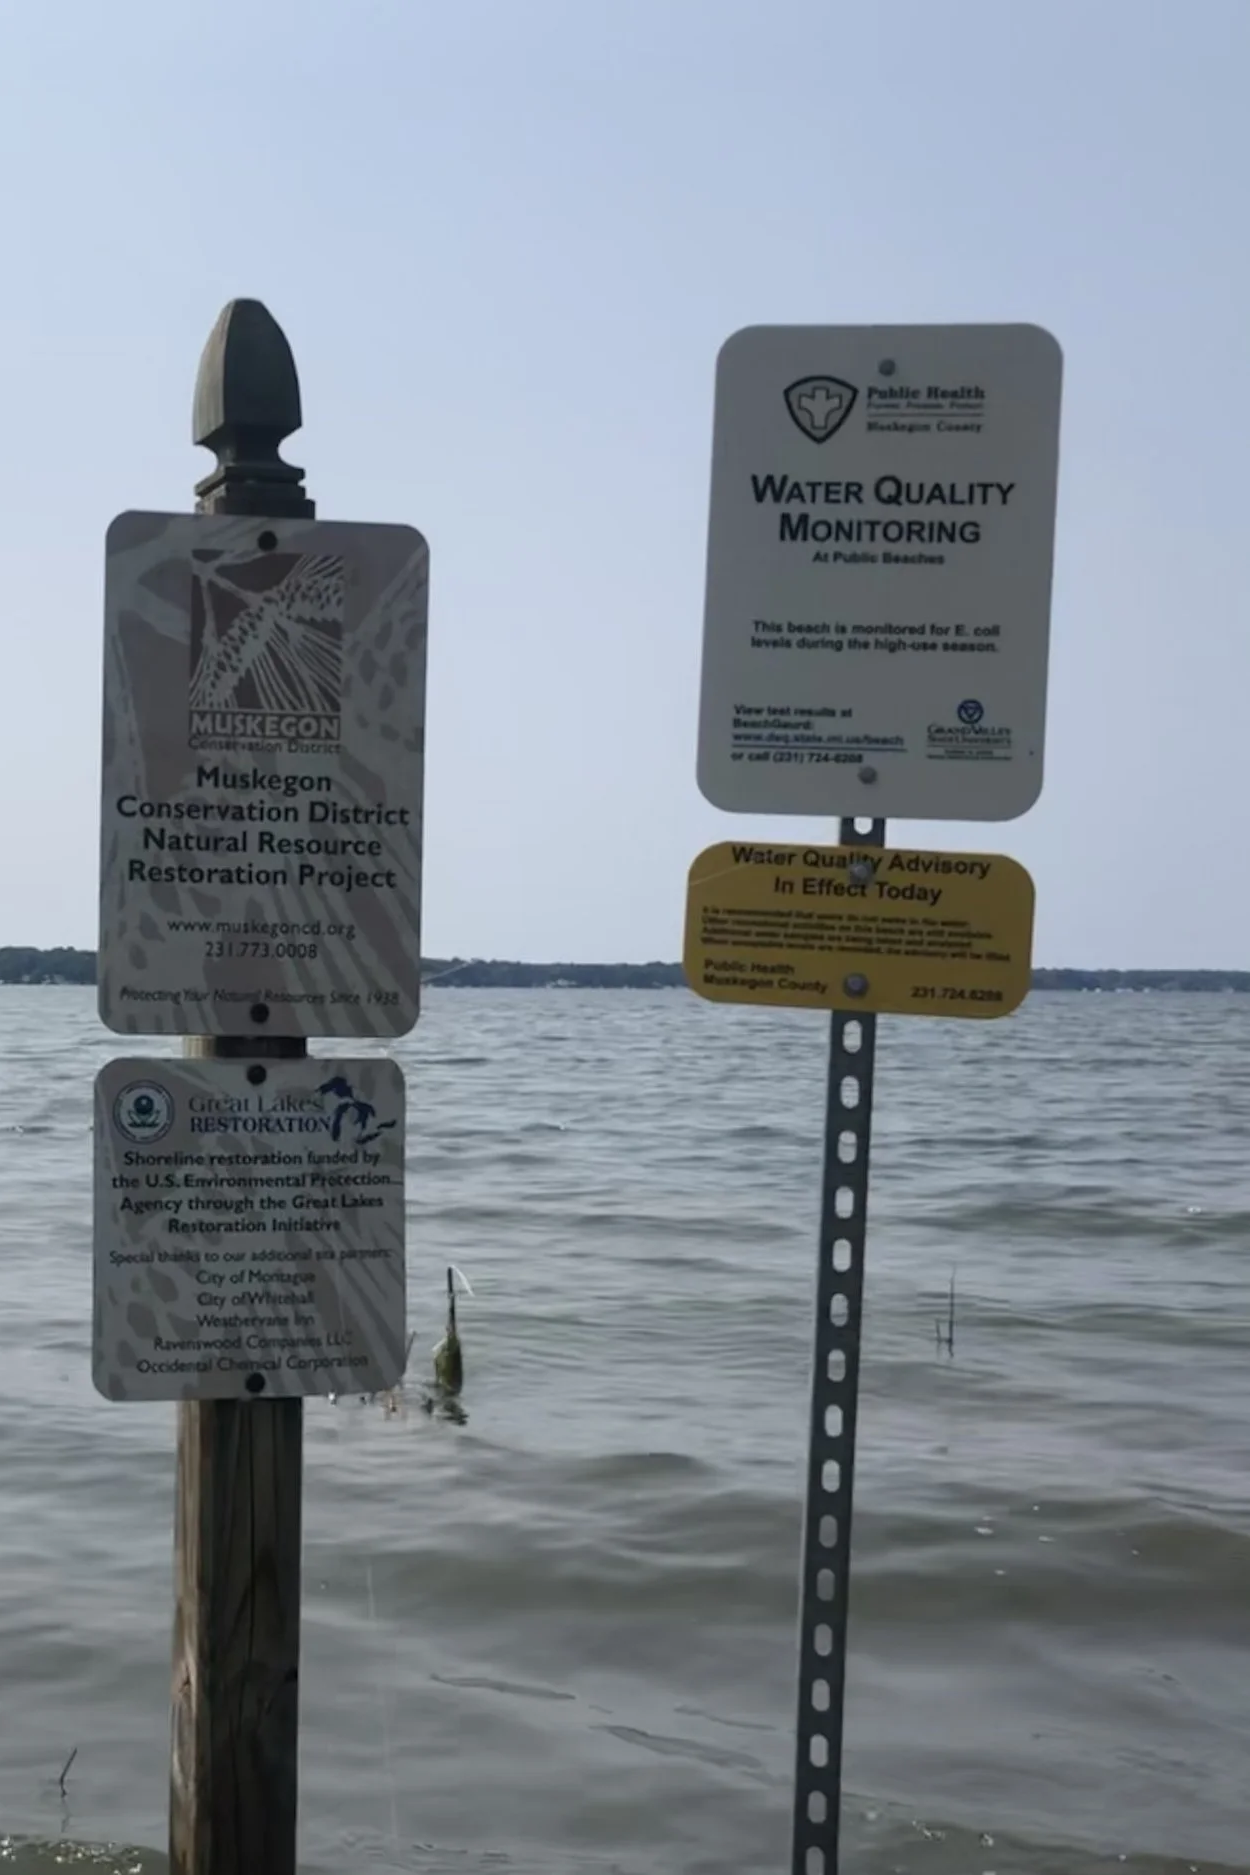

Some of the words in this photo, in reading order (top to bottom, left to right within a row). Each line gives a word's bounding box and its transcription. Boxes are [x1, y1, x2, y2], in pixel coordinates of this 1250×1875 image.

[867, 386, 919, 400] Public
[927, 385, 985, 400] Health
[751, 474, 864, 504] WATER
[874, 475, 1015, 506] QUALITY
[780, 512, 981, 543] MONITORING
[812, 550, 829, 563] At
[833, 551, 878, 564] Public
[883, 552, 944, 565] Beaches
[753, 620, 782, 634] This
[787, 621, 830, 635] beach
[834, 622, 847, 635] is
[852, 622, 925, 636] monitored
[930, 623, 951, 636] for
[973, 624, 1000, 637] coli
[751, 636, 792, 649] levels
[796, 637, 844, 653] during
[848, 638, 870, 651] the
[874, 639, 938, 654] high-use
[942, 641, 1000, 654] season.
[734, 704, 763, 716] View
[767, 705, 791, 717] test
[794, 707, 836, 718] results
[841, 708, 853, 718] at
[190, 713, 339, 739] MUSKEGON
[188, 737, 282, 753] Conservation
[288, 739, 341, 755] District
[730, 752, 744, 761] or
[748, 751, 769, 762] call
[197, 766, 331, 797] Muskegon
[116, 795, 299, 823] Conservation
[309, 801, 410, 826] District
[143, 827, 248, 852] Natural
[258, 831, 382, 856] Resource
[732, 846, 796, 866] Water
[802, 849, 882, 873] Quality
[888, 853, 992, 879] Advisory
[129, 860, 287, 886] Restoration
[298, 864, 396, 892] Project
[774, 876, 794, 895] In
[802, 877, 867, 898] Effect
[875, 881, 943, 907] Today
[167, 919, 356, 940] www.muskegoncd.org
[205, 942, 318, 959] 231.773.0008
[703, 959, 746, 973] Public
[750, 962, 795, 975] Health
[703, 973, 774, 991] Muskegon
[778, 977, 828, 995] County
[189, 1096, 249, 1114] Great
[257, 1096, 325, 1113] Lakes
[190, 1115, 331, 1134] RESTORATION
[124, 1150, 204, 1167] Shoreline
[209, 1151, 302, 1166] restoration
[307, 1149, 360, 1165] funded
[362, 1149, 381, 1167] by
[112, 1173, 139, 1189] the
[145, 1174, 180, 1189] U.S.
[184, 1172, 305, 1188] Environmental
[310, 1171, 391, 1187] Protection
[120, 1197, 183, 1214] Agency
[188, 1197, 254, 1214] through
[259, 1196, 288, 1210] the
[292, 1195, 337, 1210] Great
[341, 1194, 384, 1208] Lakes
[168, 1217, 266, 1234] Restoration
[272, 1216, 341, 1232] Initiative
[109, 1250, 154, 1267] Special
[158, 1250, 201, 1262] thanks
[204, 1250, 219, 1262] to
[223, 1252, 246, 1262] our
[195, 1269, 226, 1287] City
[230, 1268, 246, 1285] of
[249, 1268, 316, 1286] Montague
[196, 1290, 226, 1309] City
[231, 1290, 248, 1306] of
[153, 1335, 241, 1352] Ravenswood
[246, 1334, 322, 1350] Companies
[136, 1358, 212, 1375] Occidental
[216, 1356, 282, 1373] Chemical
